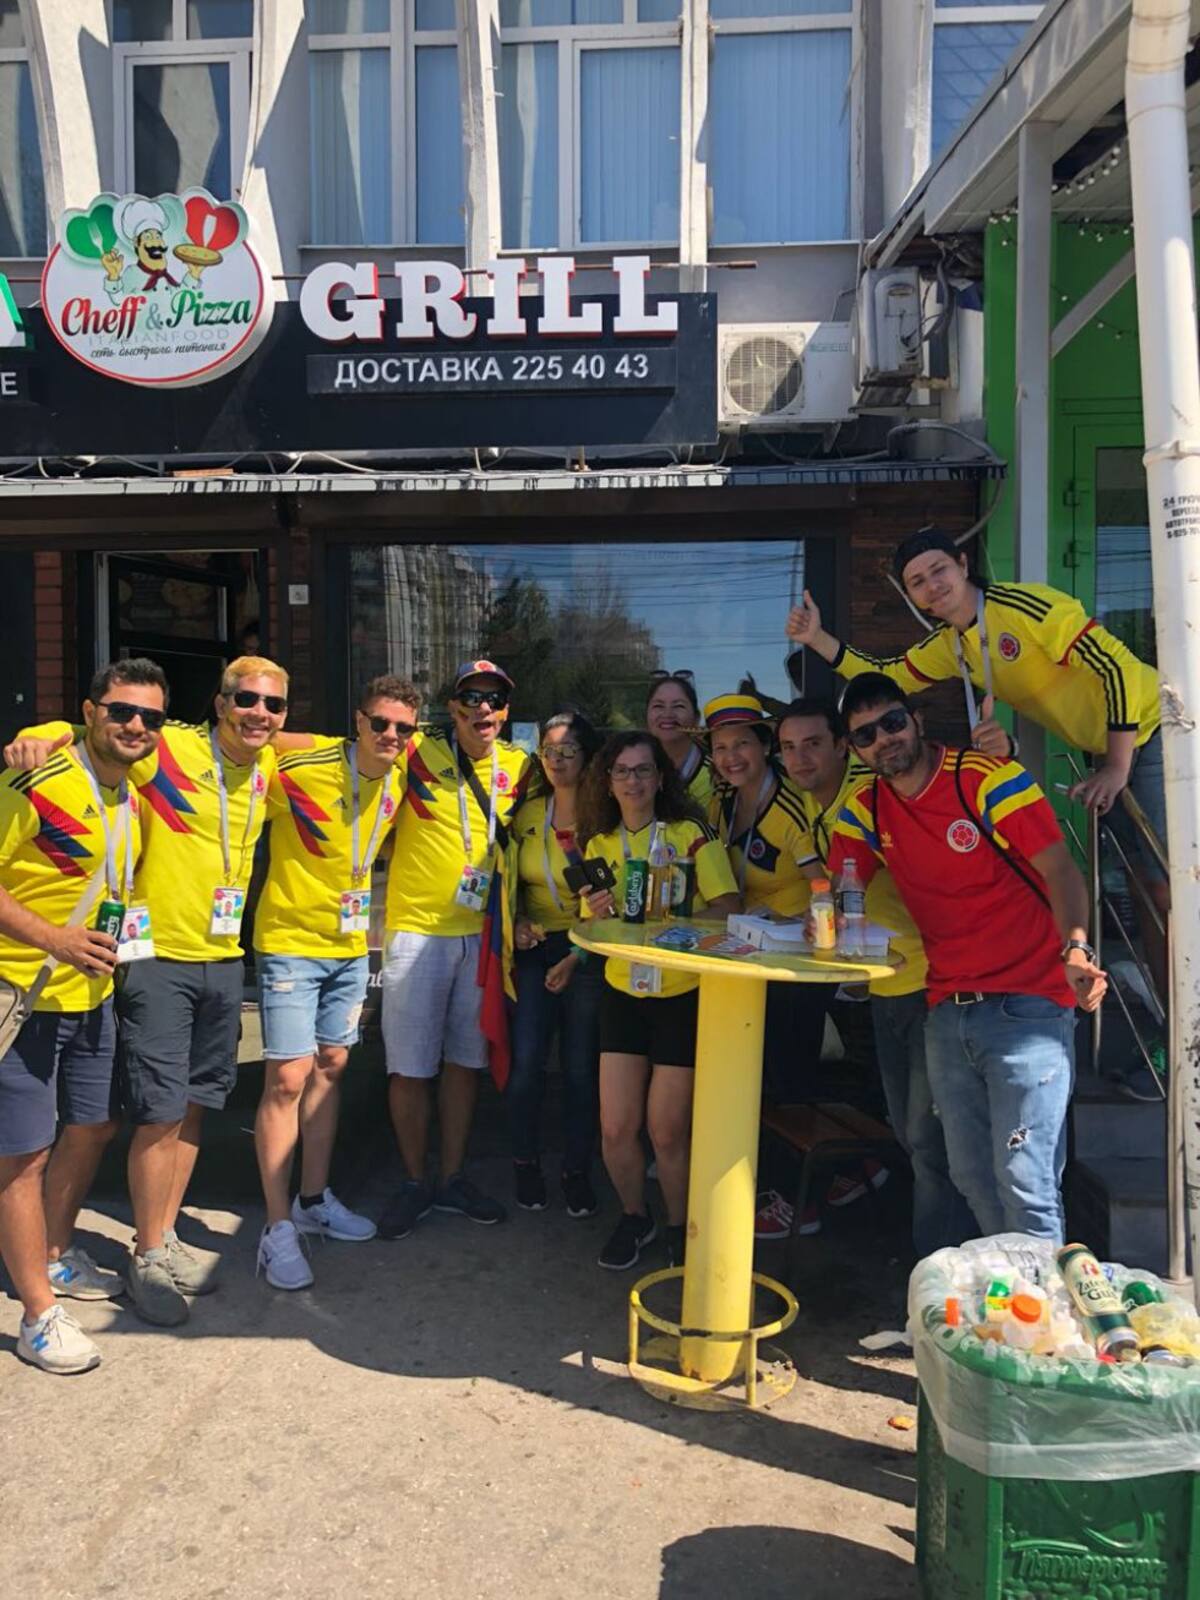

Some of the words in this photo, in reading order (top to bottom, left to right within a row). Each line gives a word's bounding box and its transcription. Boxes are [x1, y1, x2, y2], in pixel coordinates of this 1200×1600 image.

[61, 295, 147, 339] Cheff
[146, 303, 164, 330] &
[166, 289, 253, 329] Pizza
[300, 255, 679, 343] GRILL
[175, 343, 226, 354] питания
[334, 356, 504, 388] ДОСТАВКА
[512, 355, 564, 381] 225
[572, 355, 604, 379] 40
[614, 354, 650, 379] 43
[623, 870, 644, 916] Carlsberg
